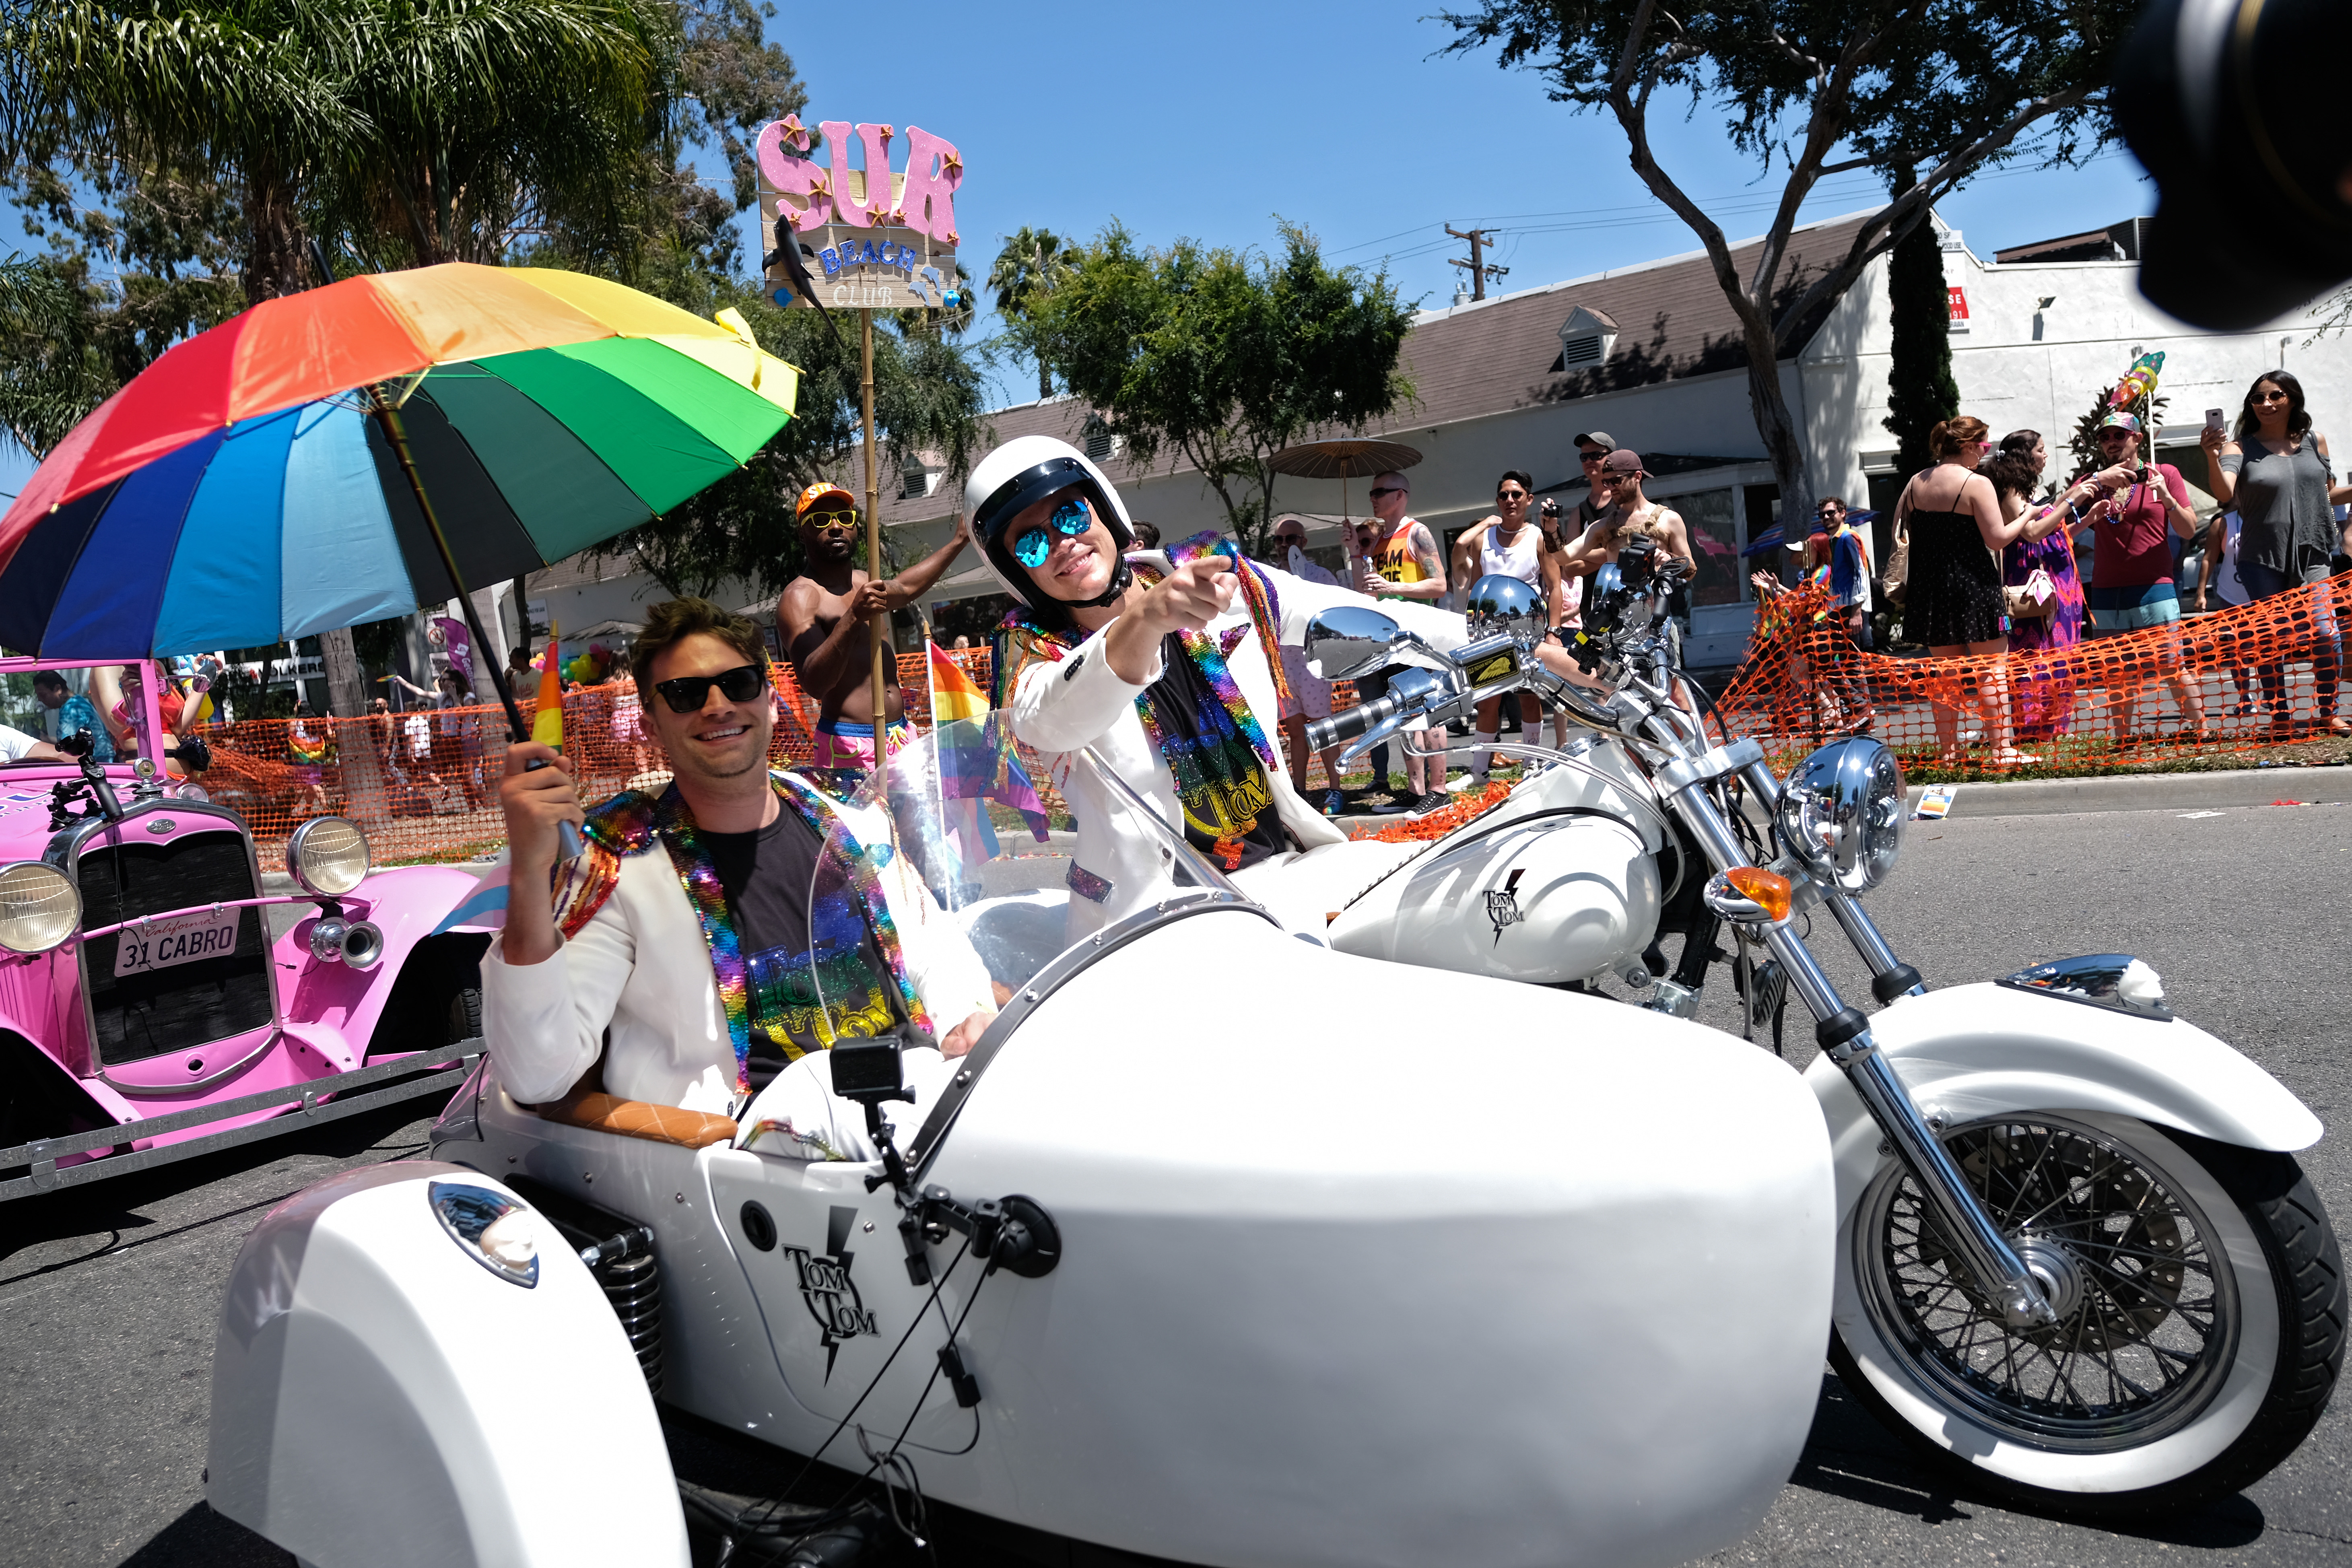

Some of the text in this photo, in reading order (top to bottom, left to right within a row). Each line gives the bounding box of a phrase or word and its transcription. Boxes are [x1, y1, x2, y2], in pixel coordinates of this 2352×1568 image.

[757, 113, 963, 247] SUR
[818, 239, 917, 275] BEACH
[833, 285, 892, 306] CLUB
[1482, 889, 1513, 910] TOM
[1492, 906, 1525, 925] TOM
[146, 917, 218, 937] California
[123, 926, 233, 968] 31 CABRO
[748, 944, 858, 1029] TOM
[781, 1243, 849, 1294] TOM
[813, 1288, 881, 1338] TOM
